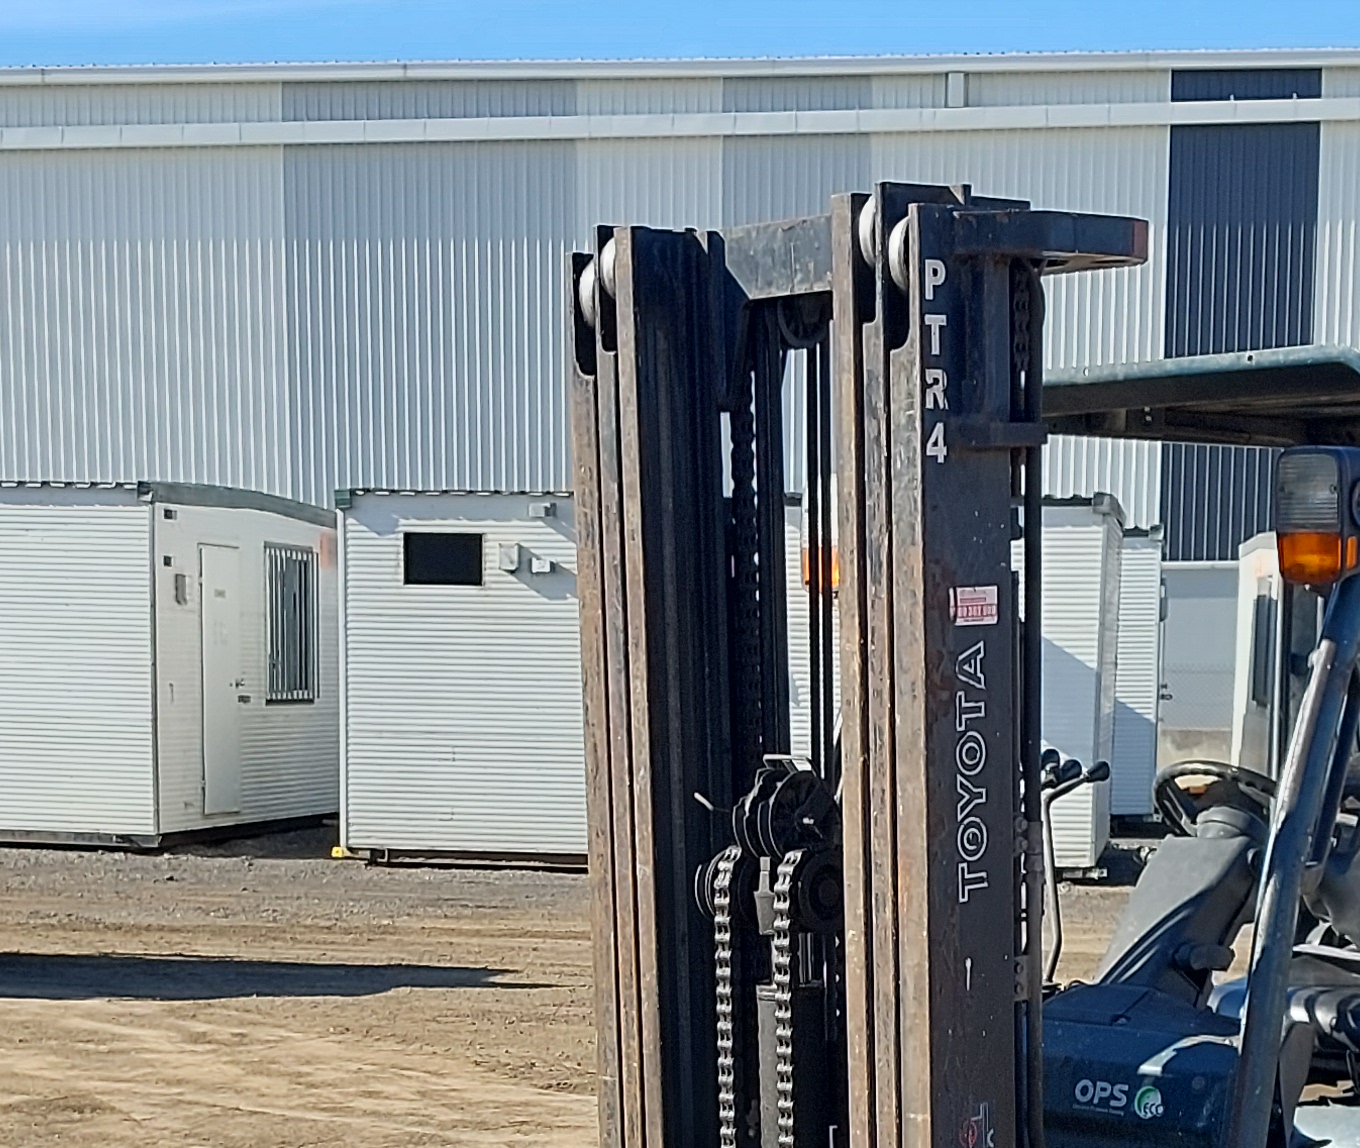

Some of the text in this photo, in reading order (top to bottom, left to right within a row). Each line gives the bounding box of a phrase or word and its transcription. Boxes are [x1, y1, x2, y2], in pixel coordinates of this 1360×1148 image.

[924, 258, 949, 464] PTR4
[955, 640, 989, 903] TOYOTA
[1074, 1078, 1129, 1107] OPS
